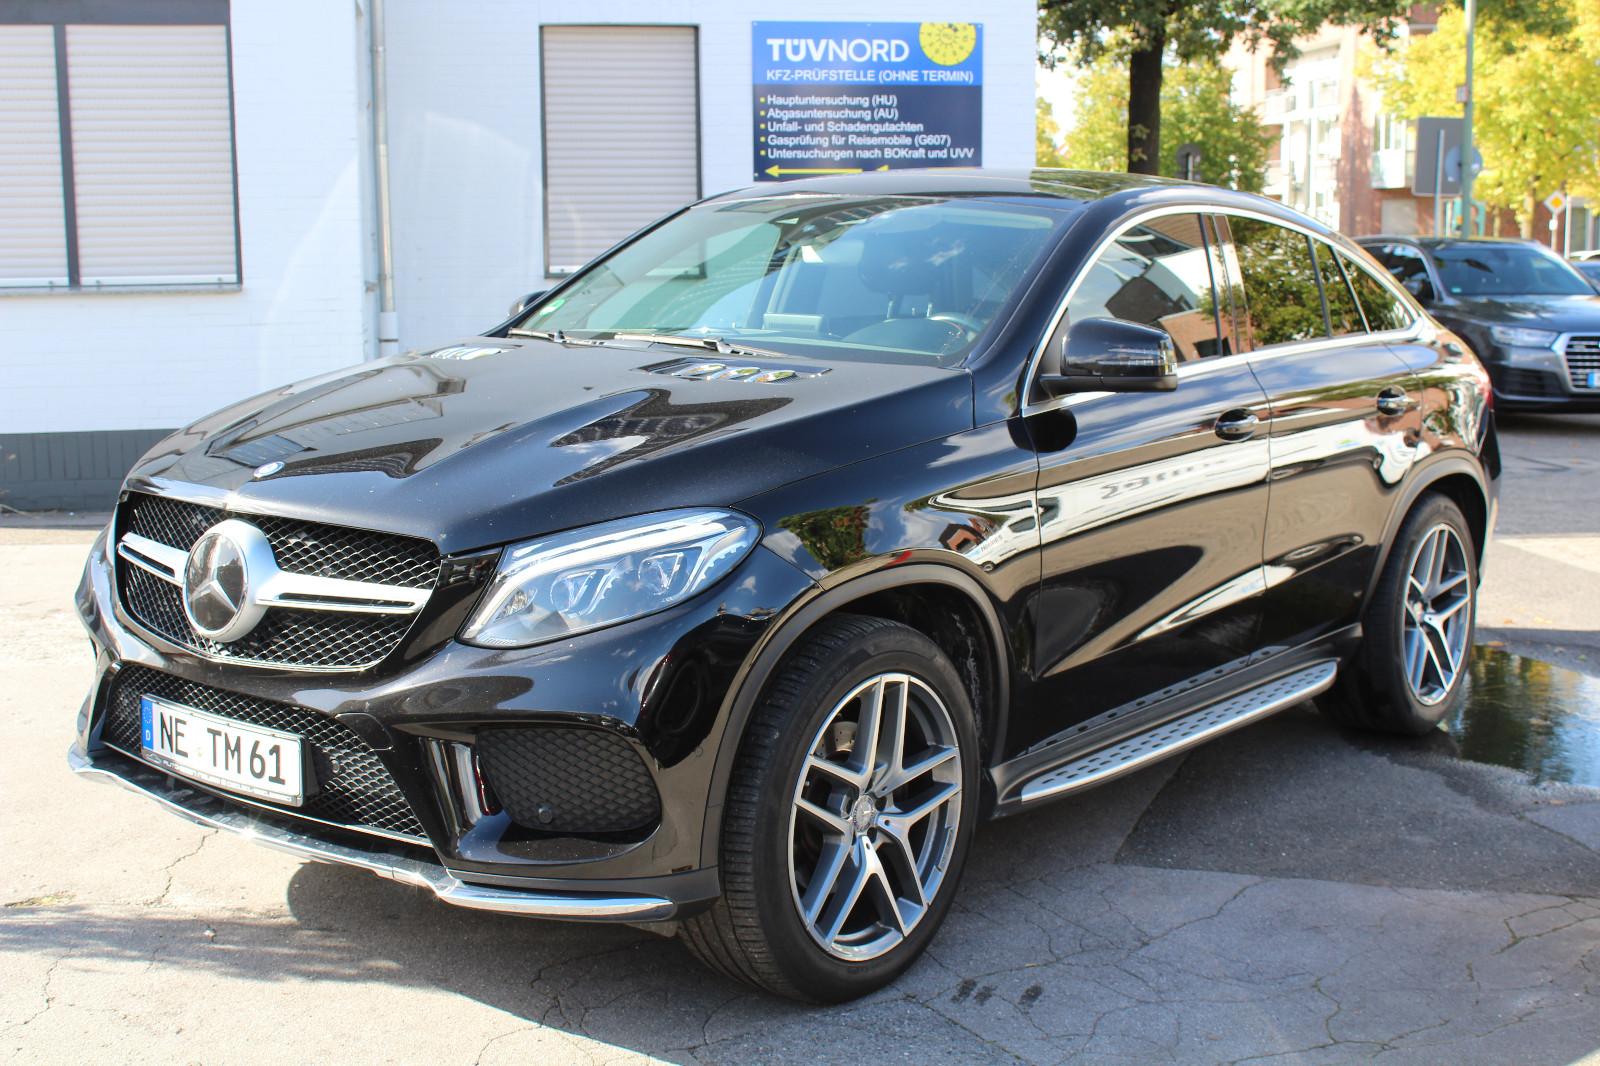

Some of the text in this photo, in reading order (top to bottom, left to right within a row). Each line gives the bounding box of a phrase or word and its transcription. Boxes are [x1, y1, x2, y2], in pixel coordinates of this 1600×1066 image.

[766, 69, 974, 84] KFZ-PRÜFSTELLE (OHNE TERMIN)
[767, 94, 897, 107] Hauptuntersuchung (HU)
[767, 108, 899, 121] Abgasuntersuchung (AU)
[767, 121, 924, 134] Unfall- und Schadengutachten
[767, 134, 951, 147] Gasprüfung für Reisemobile (G607)
[767, 148, 975, 160] Untersuchungen nach BOKraft und UVV
[145, 729, 151, 741] D
[160, 711, 188, 758] NE
[207, 727, 241, 774] TM
[249, 739, 286, 785] 61
